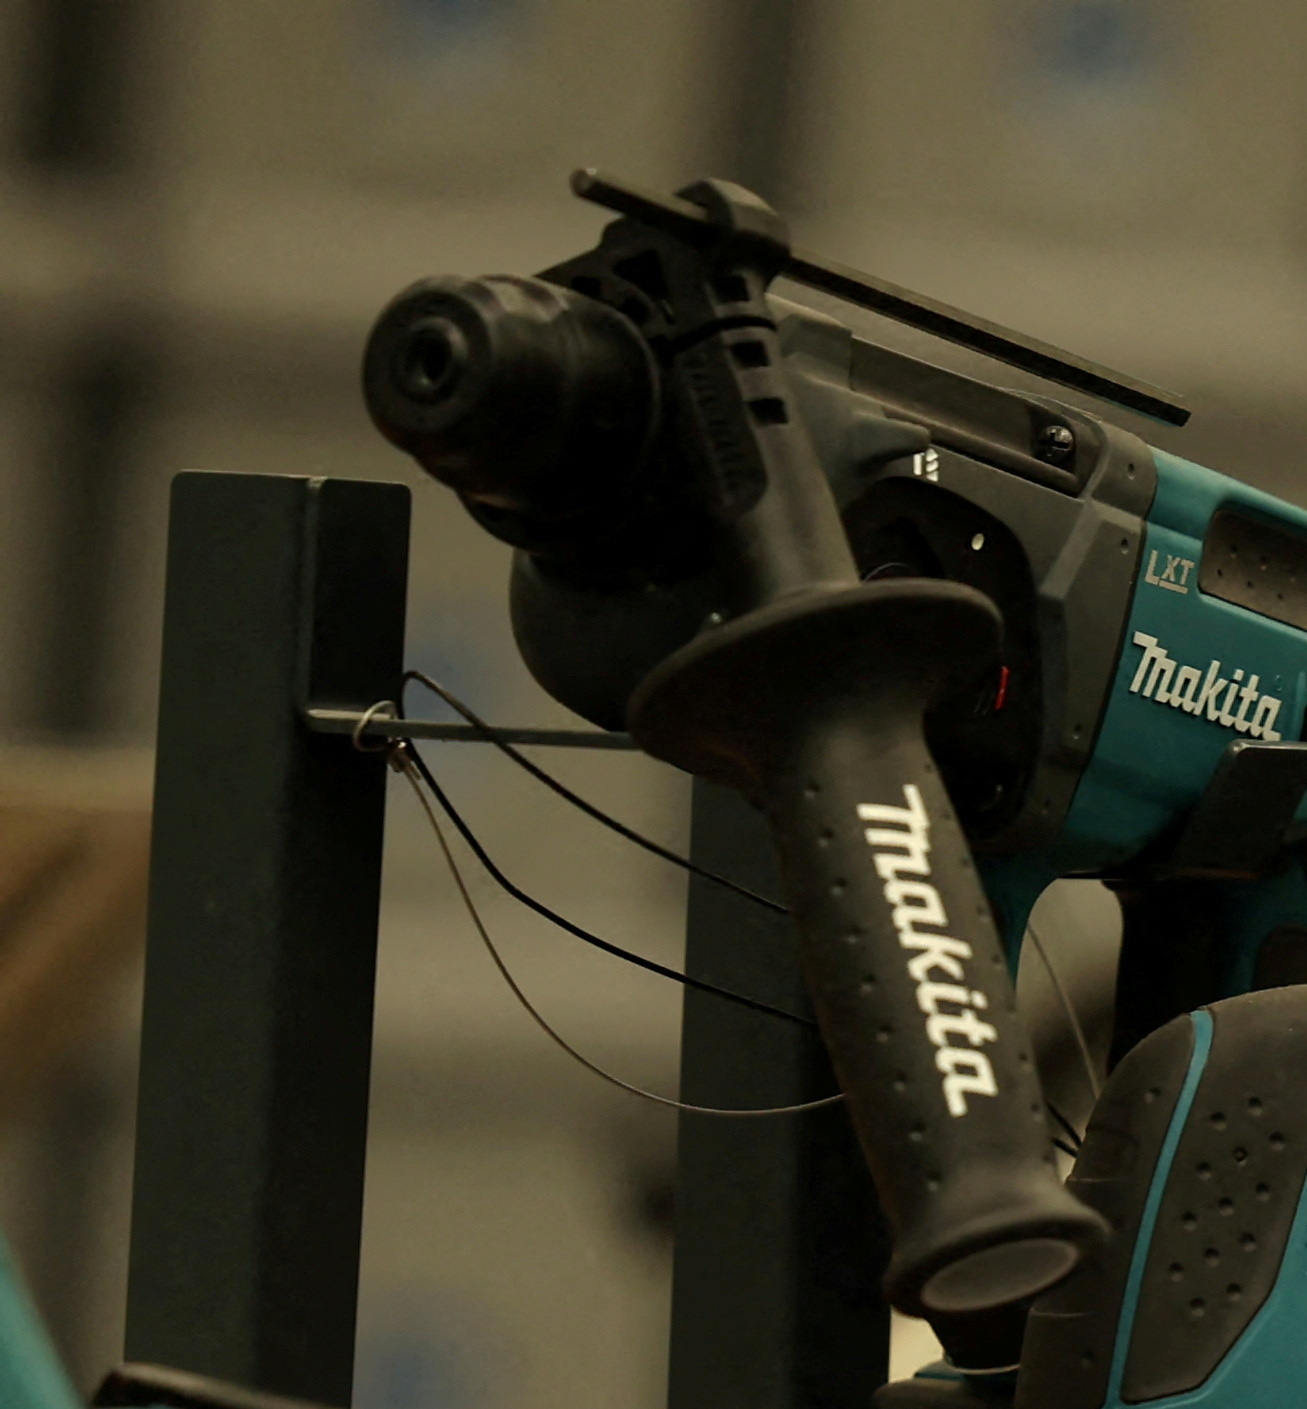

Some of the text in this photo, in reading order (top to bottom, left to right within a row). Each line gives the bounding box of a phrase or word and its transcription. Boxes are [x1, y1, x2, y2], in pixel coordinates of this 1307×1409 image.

[1146, 550, 1195, 594] LXT
[1129, 631, 1281, 741] Makita
[857, 784, 998, 1117] Makita
